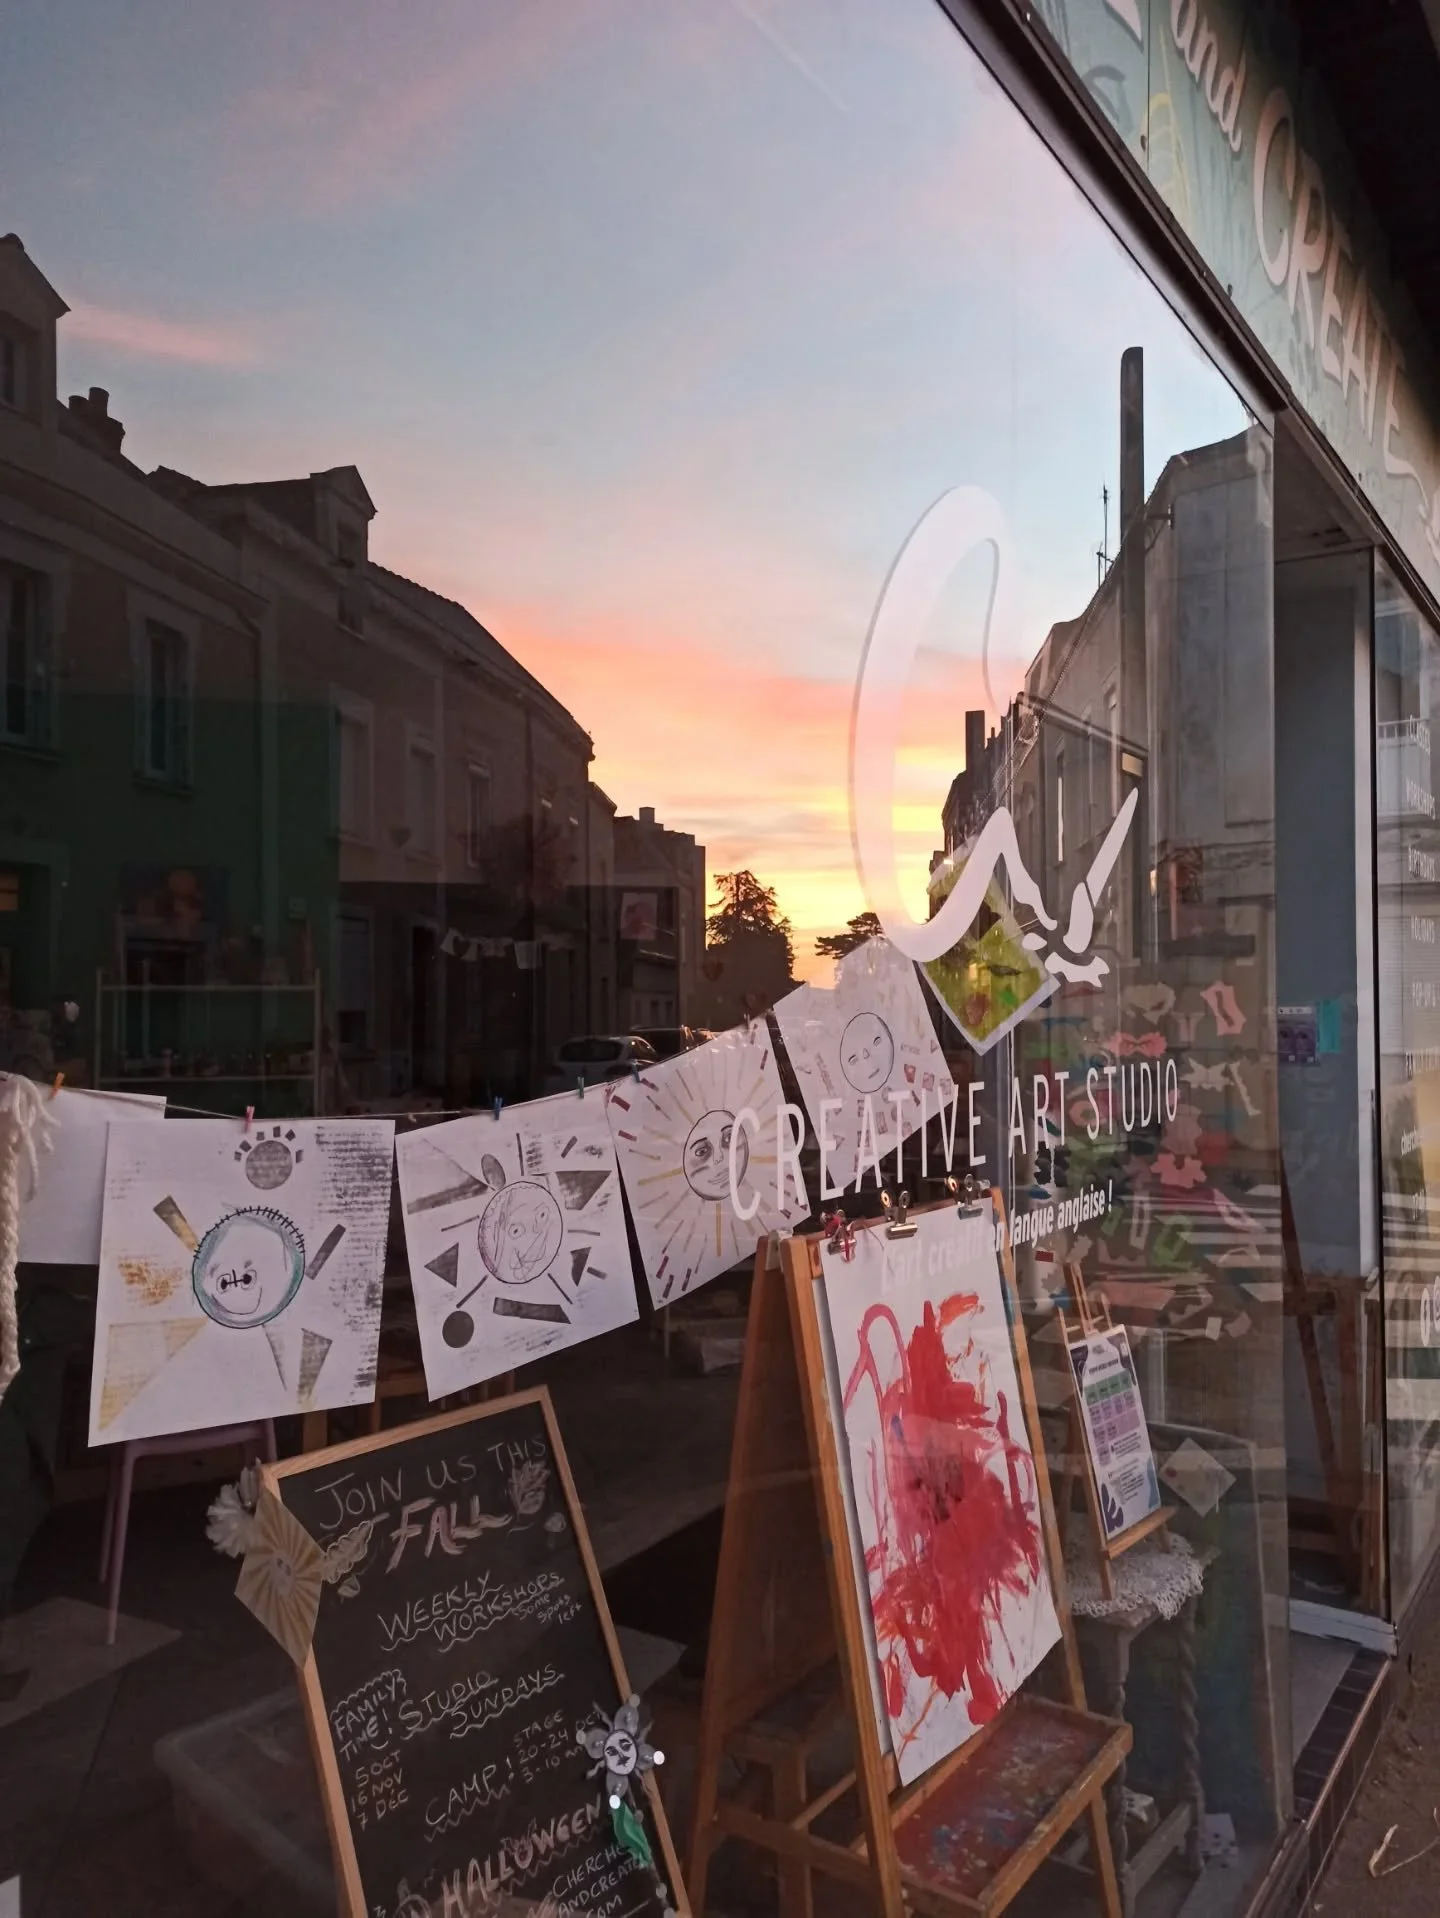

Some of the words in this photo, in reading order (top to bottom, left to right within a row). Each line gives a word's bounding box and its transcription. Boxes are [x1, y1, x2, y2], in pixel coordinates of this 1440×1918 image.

[728, 1081, 986, 1221] CREATIVE
[1008, 1071, 1070, 1158] ART
[1086, 1058, 1179, 1140] STUDIO
[1009, 1207, 1054, 1249] langue
[315, 1467, 402, 1530] JOIN
[426, 1455, 477, 1489] US
[488, 1436, 546, 1472] THIS
[385, 1494, 512, 1574] FALL
[377, 1569, 502, 1641] WEEKLY
[433, 1572, 562, 1642] WORKSHOPS
[335, 1675, 396, 1739] FAMILY
[399, 1671, 494, 1731] STUDIO
[450, 1663, 558, 1732] SUNDAYS
[370, 1750, 401, 1776] OCT
[371, 1767, 404, 1796] NOV
[441, 1793, 602, 1918] HALLOWEEN
